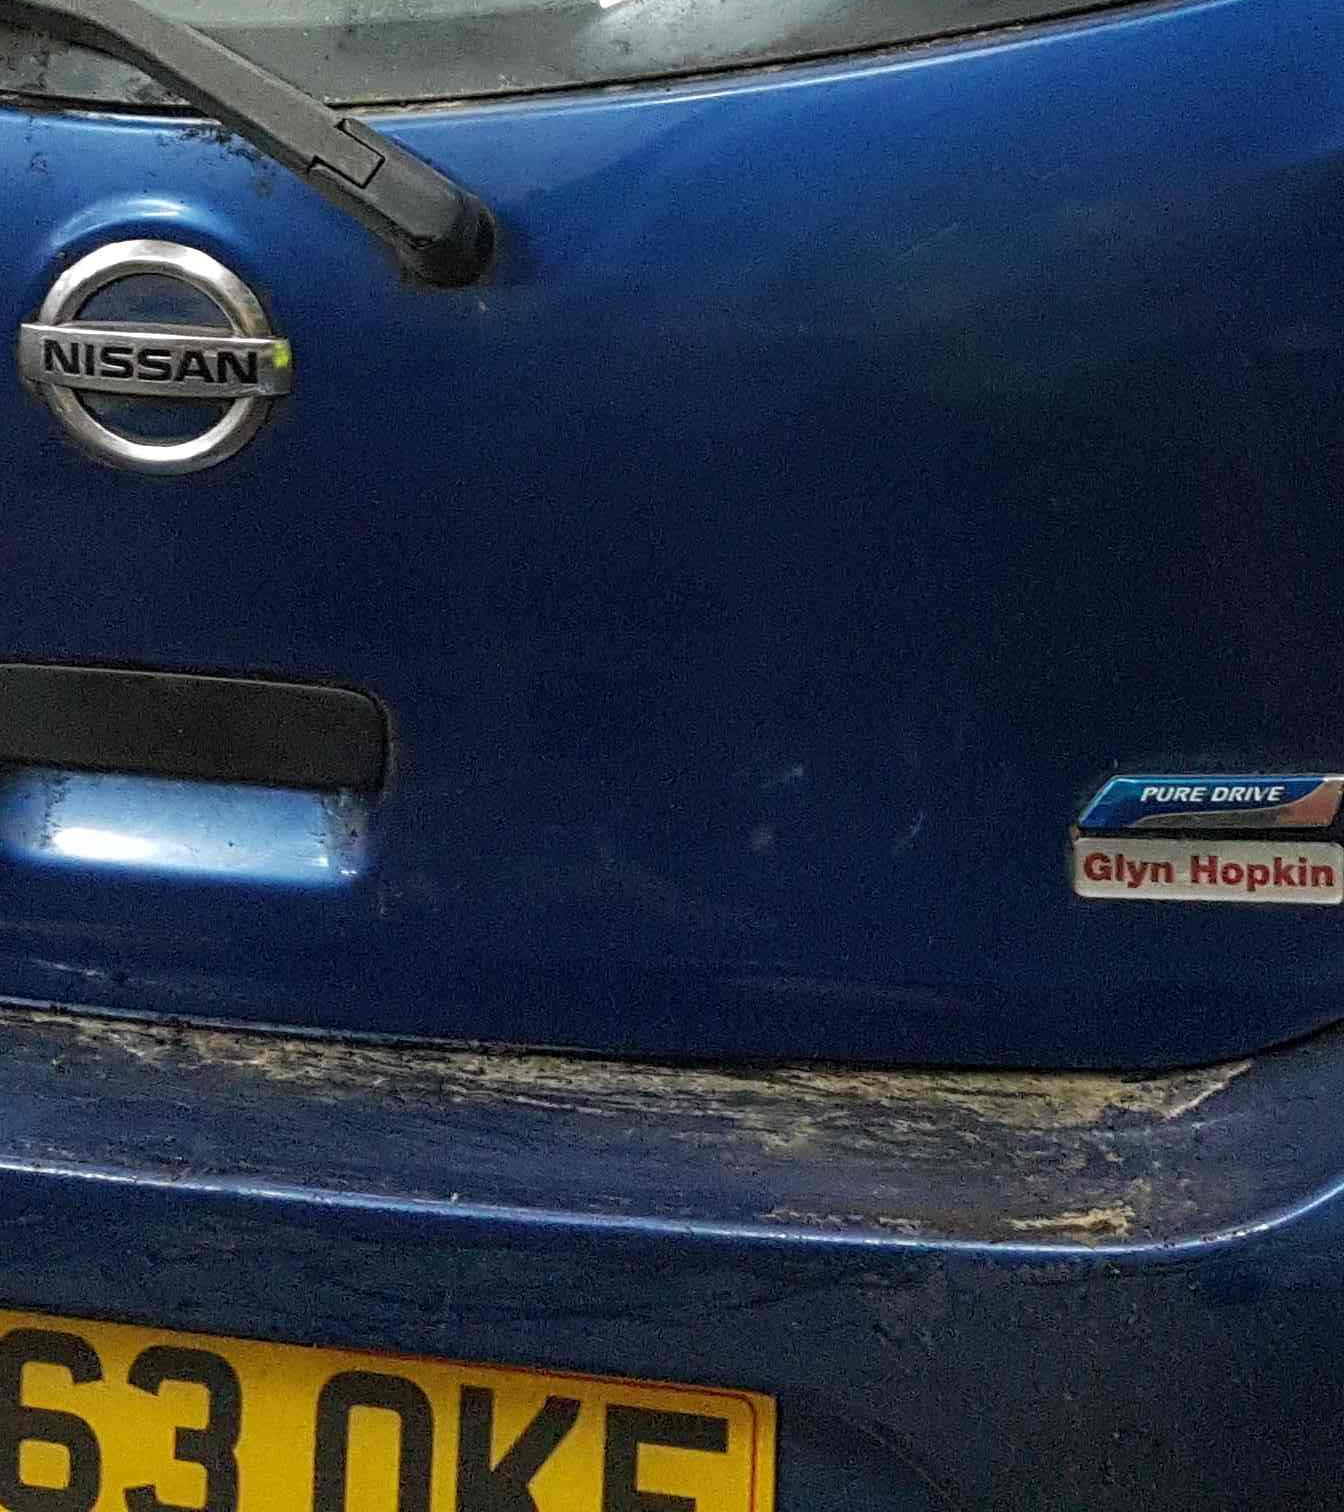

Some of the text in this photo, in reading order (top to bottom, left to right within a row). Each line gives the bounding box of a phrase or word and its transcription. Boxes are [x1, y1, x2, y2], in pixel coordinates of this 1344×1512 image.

[43, 339, 257, 384] NISSAN
[1140, 786, 1286, 803] PURE DRIVE
[1082, 851, 1335, 893] Glyn Hopkin
